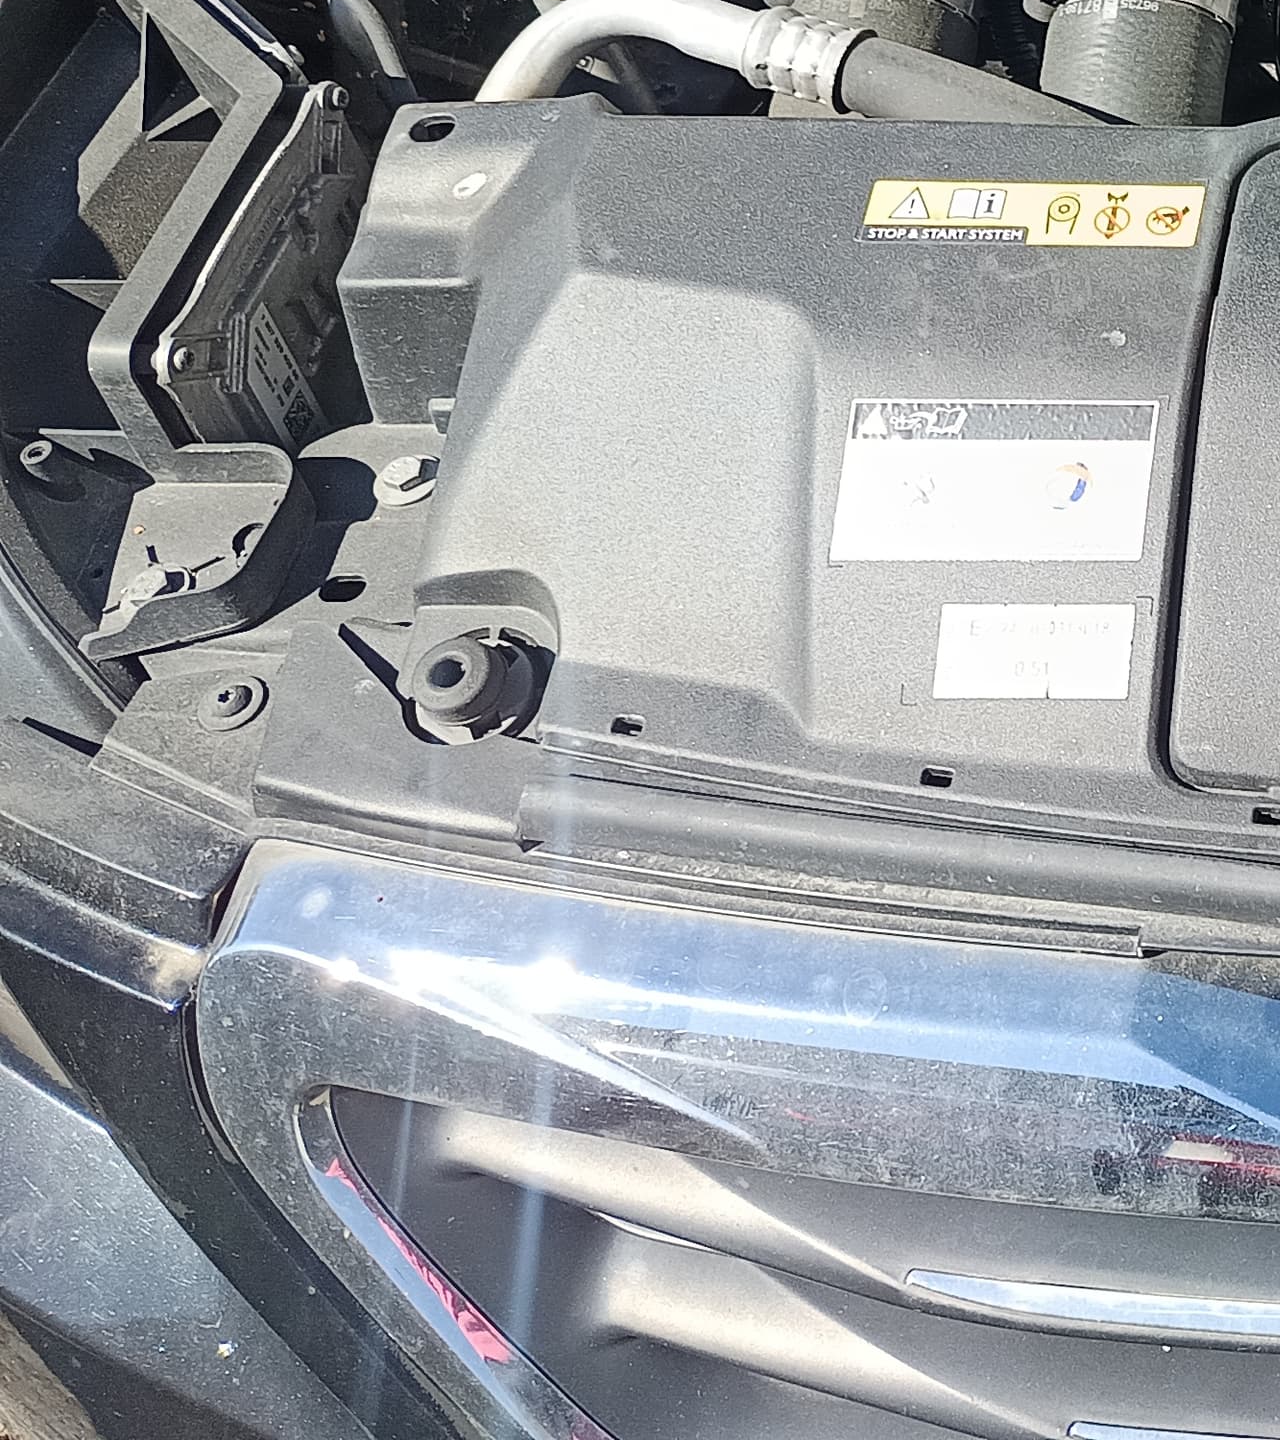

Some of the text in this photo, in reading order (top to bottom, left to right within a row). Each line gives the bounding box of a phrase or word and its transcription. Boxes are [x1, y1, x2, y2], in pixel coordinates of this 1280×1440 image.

[867, 227, 1024, 242] STOP & START SYSTEM
